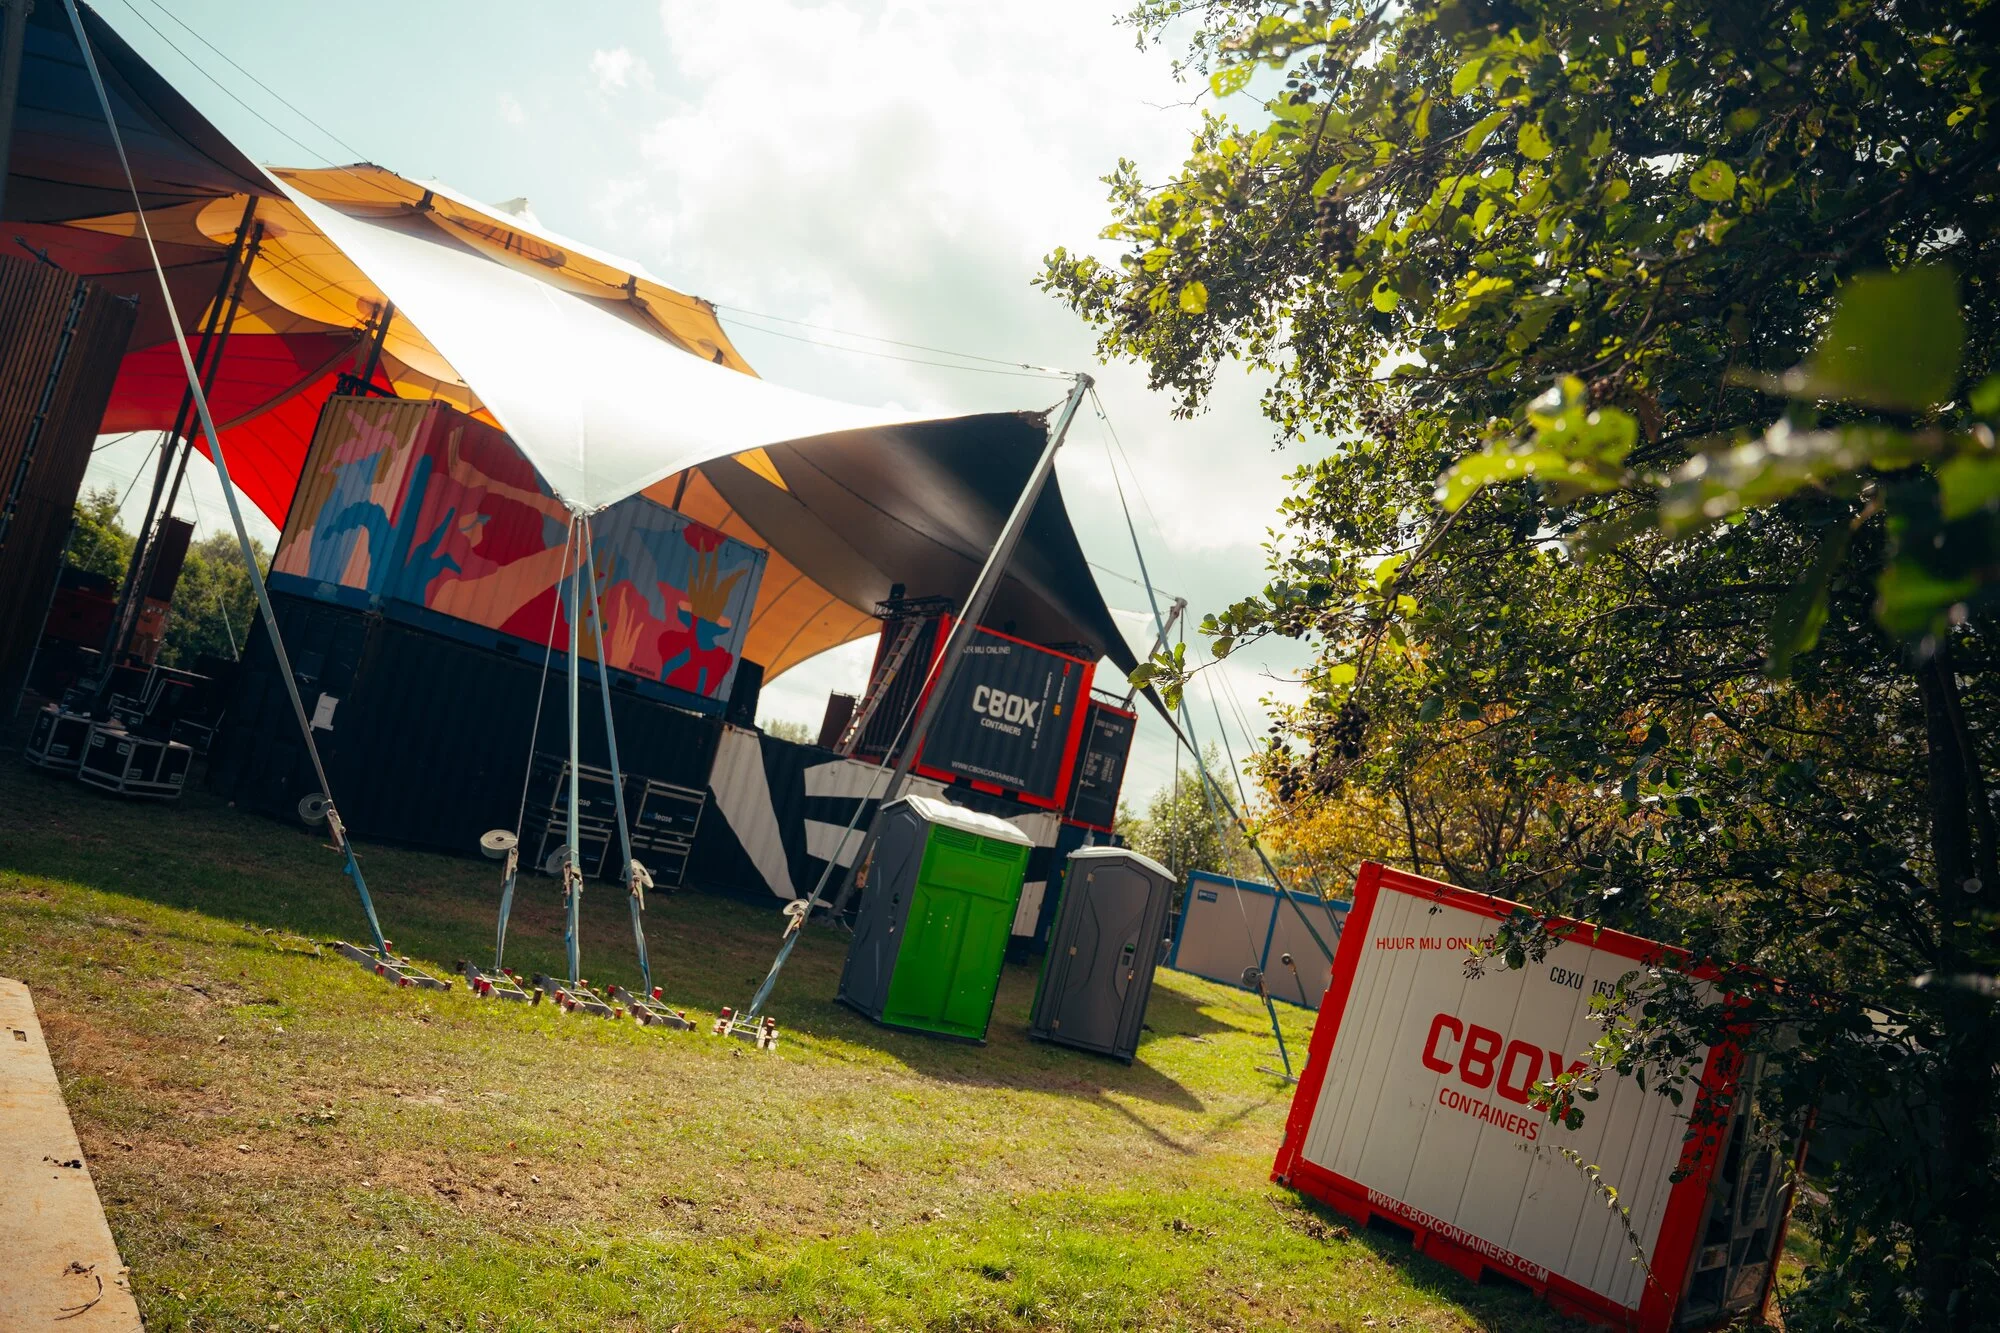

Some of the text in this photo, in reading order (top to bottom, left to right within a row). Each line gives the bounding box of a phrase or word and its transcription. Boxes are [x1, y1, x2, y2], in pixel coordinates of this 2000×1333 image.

[986, 646, 1011, 654] ONLINE
[973, 685, 1040, 728] CBOX
[981, 718, 1021, 736] CONTAINERS
[1376, 937, 1415, 950] HUUR
[1420, 937, 1442, 950] MIJ
[1549, 966, 1584, 990] CBXU
[1422, 1013, 1589, 1121] CBOX
[1439, 1087, 1540, 1141] CONTAINERS
[1368, 1188, 1549, 1284] WWW.CBOXCONTAINERS.COM
